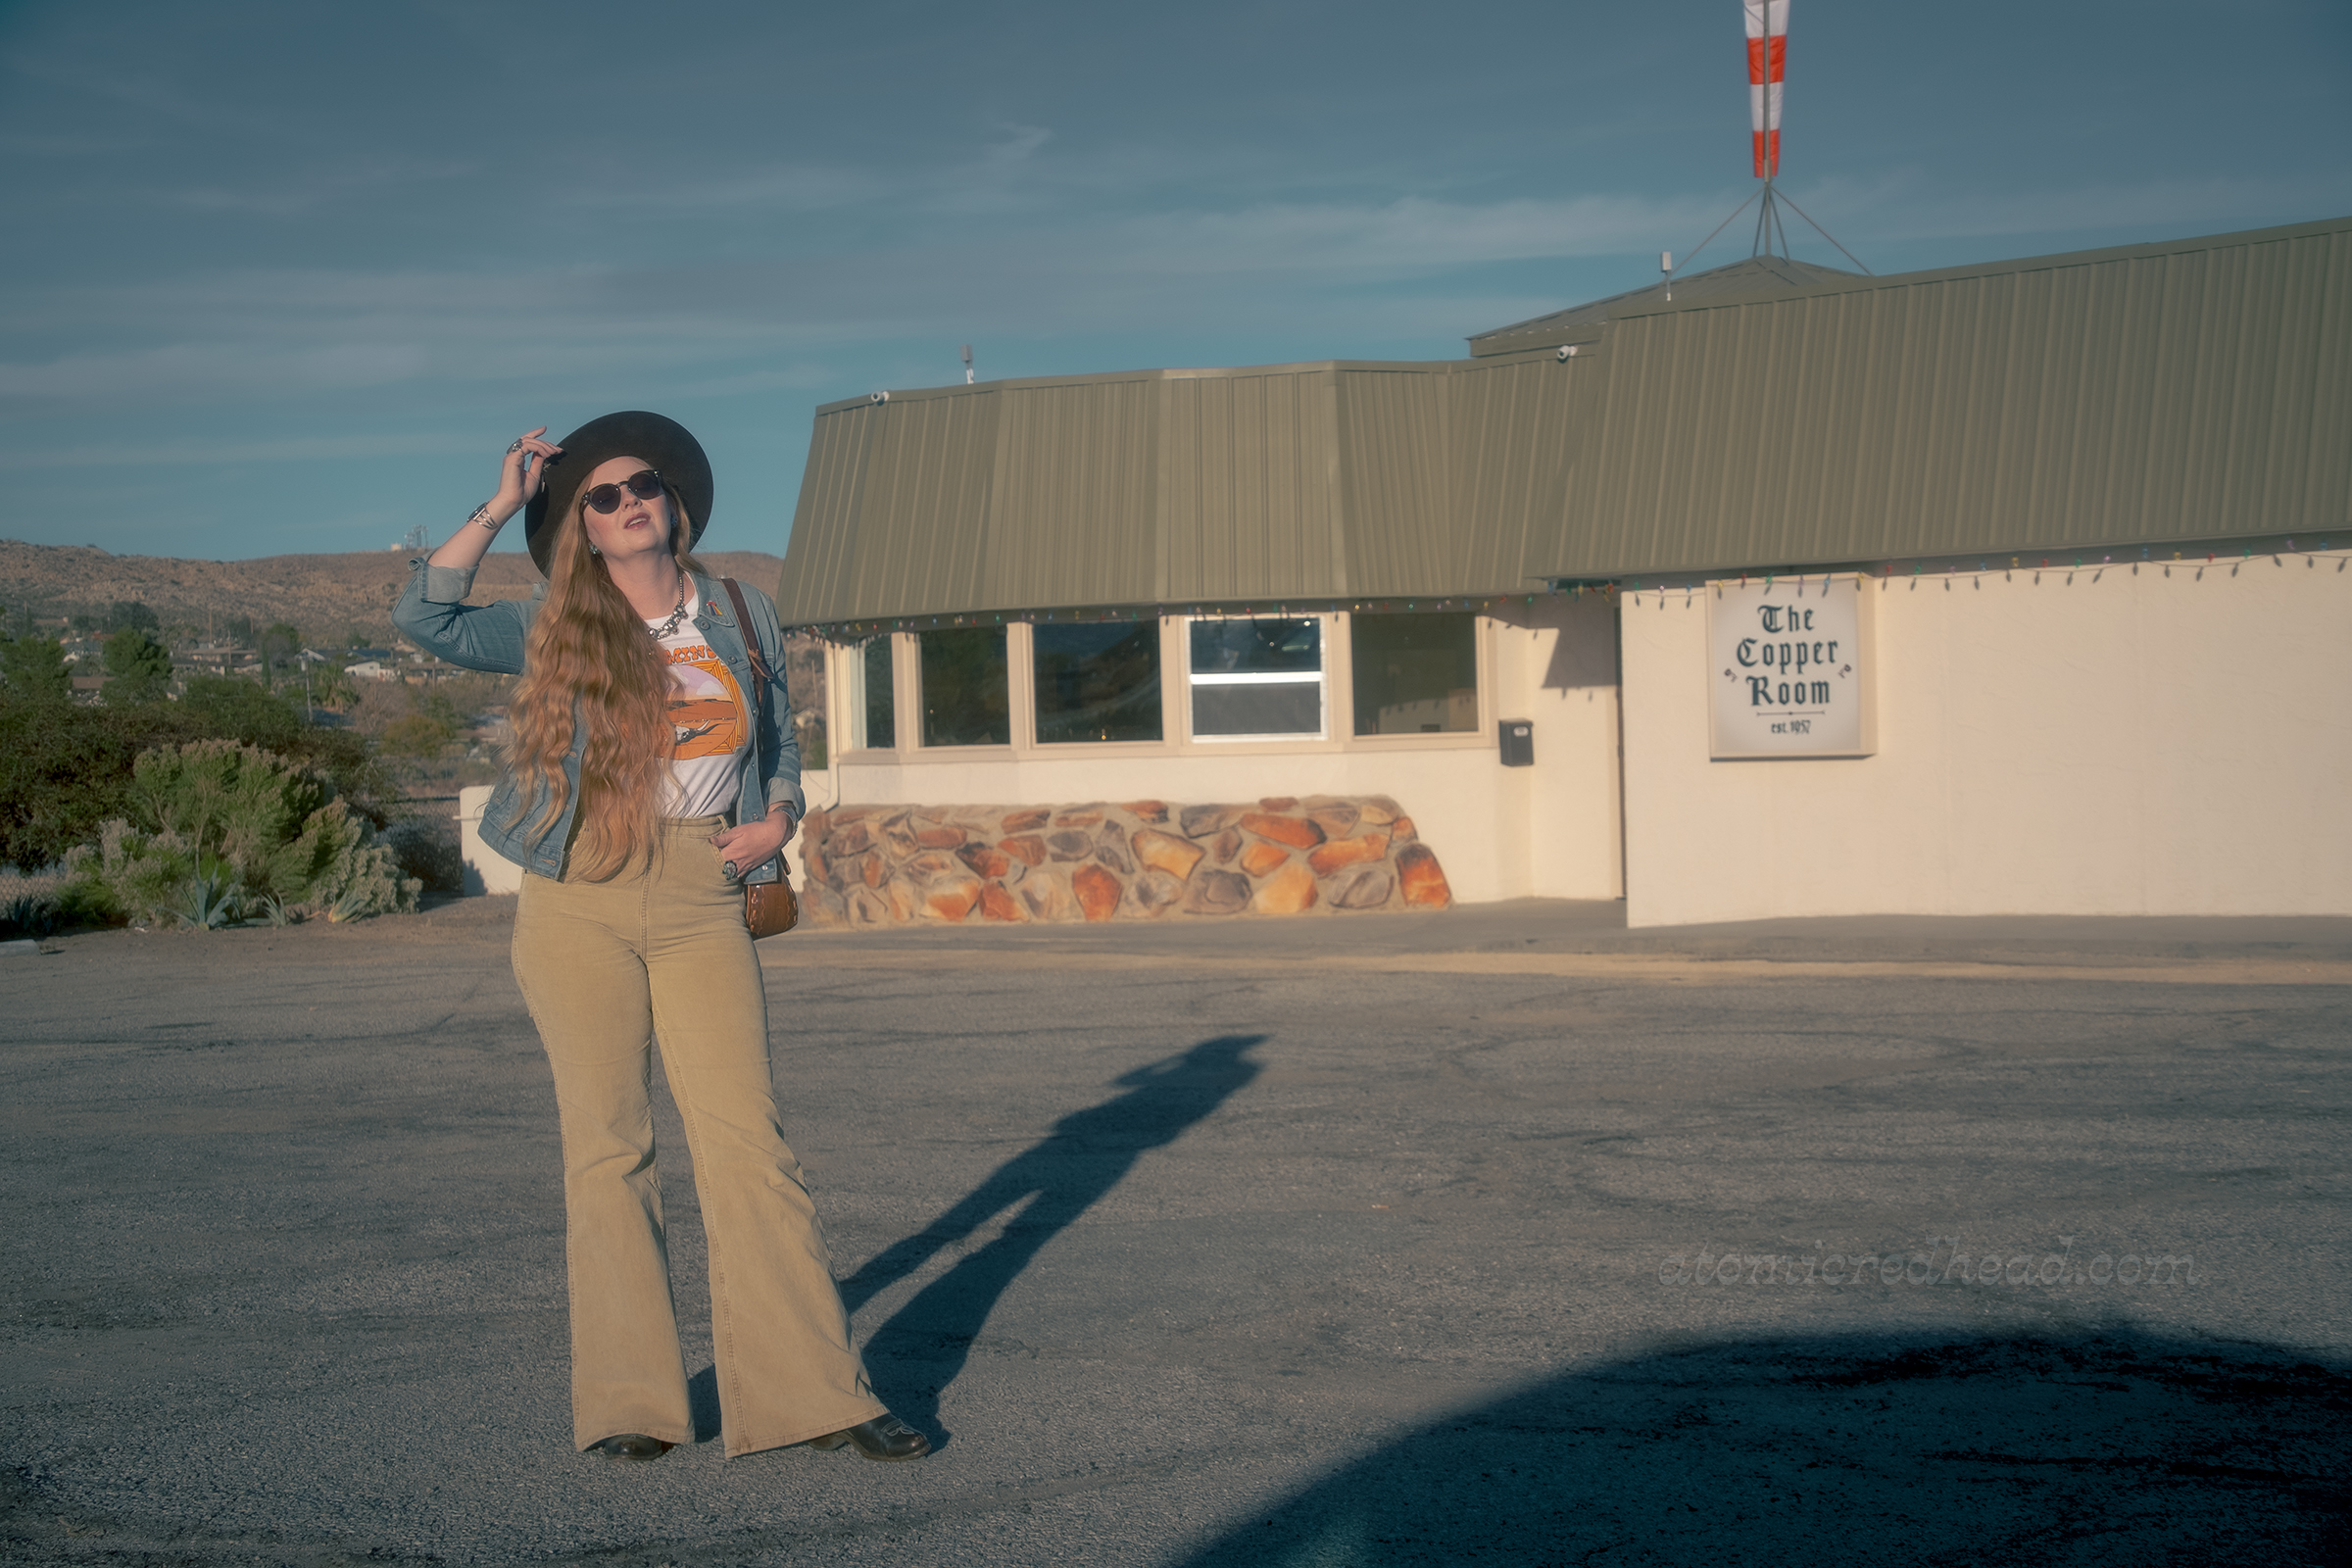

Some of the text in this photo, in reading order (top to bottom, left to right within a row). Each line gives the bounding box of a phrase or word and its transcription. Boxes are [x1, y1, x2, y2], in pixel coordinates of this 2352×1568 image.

[1757, 605, 1814, 633] The
[1737, 637, 1838, 675] Copper
[1745, 675, 1831, 707] Room
